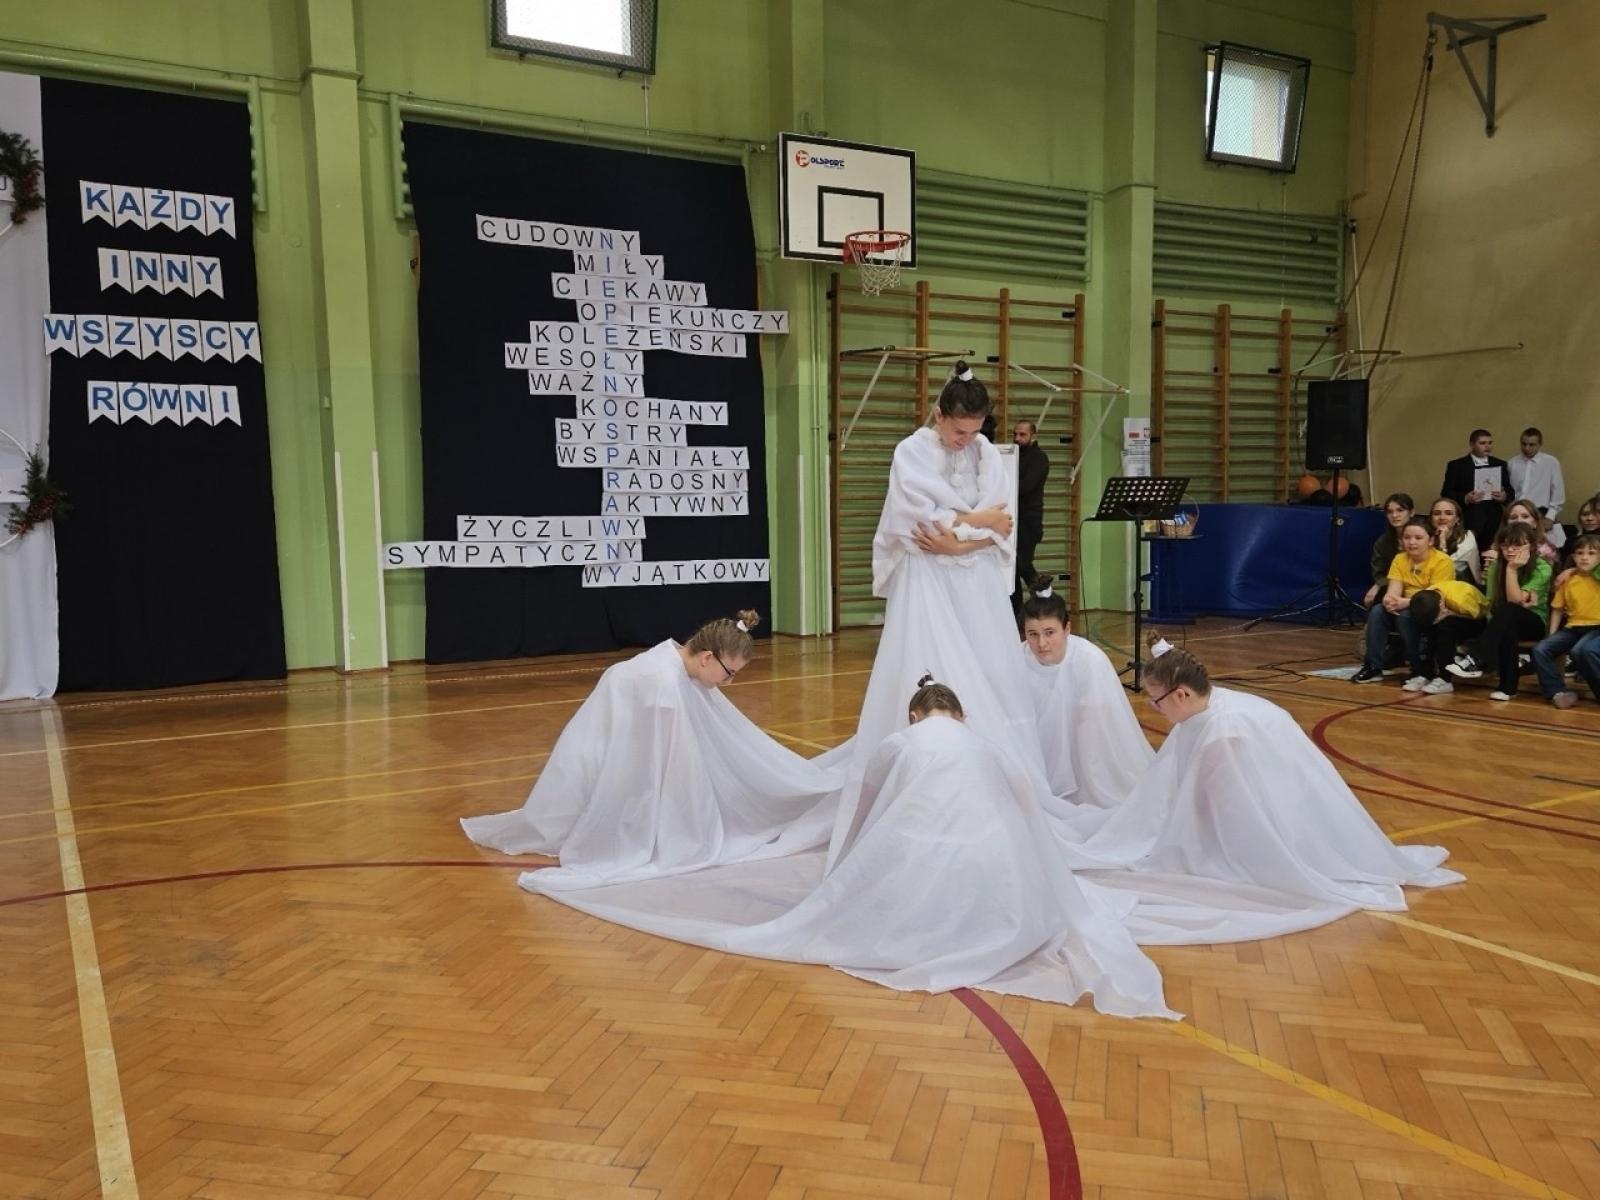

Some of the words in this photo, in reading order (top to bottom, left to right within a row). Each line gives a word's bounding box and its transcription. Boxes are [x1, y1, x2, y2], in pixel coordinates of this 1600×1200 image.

[85, 187, 230, 224] KAŻDY
[480, 219, 635, 251] CUDOWNY
[111, 254, 217, 285] INNY
[577, 253, 659, 276] MIŁY
[556, 276, 701, 302] CIEKAWY
[580, 302, 784, 330] OPIEKUŃCZY
[45, 318, 255, 350] WSZYSCY
[536, 324, 739, 353] KOLEŻEŃSKI
[507, 347, 638, 371] WESOŁY
[531, 370, 638, 393] WAŻNY
[92, 382, 230, 413] RÓWNI
[600, 231, 623, 582] NIEPEŁNOSPRAWNY
[582, 399, 724, 421] KOCHANY
[561, 422, 682, 443] BYSTRY
[558, 445, 744, 467] WSPANIAŁY
[608, 471, 744, 490] RADOSNY
[605, 494, 744, 513] AKTYWNY
[464, 516, 640, 538] ŻYCZLIWY
[388, 542, 637, 565] SYMPATYCZNY
[584, 561, 766, 586] WYJĄTKOWY
